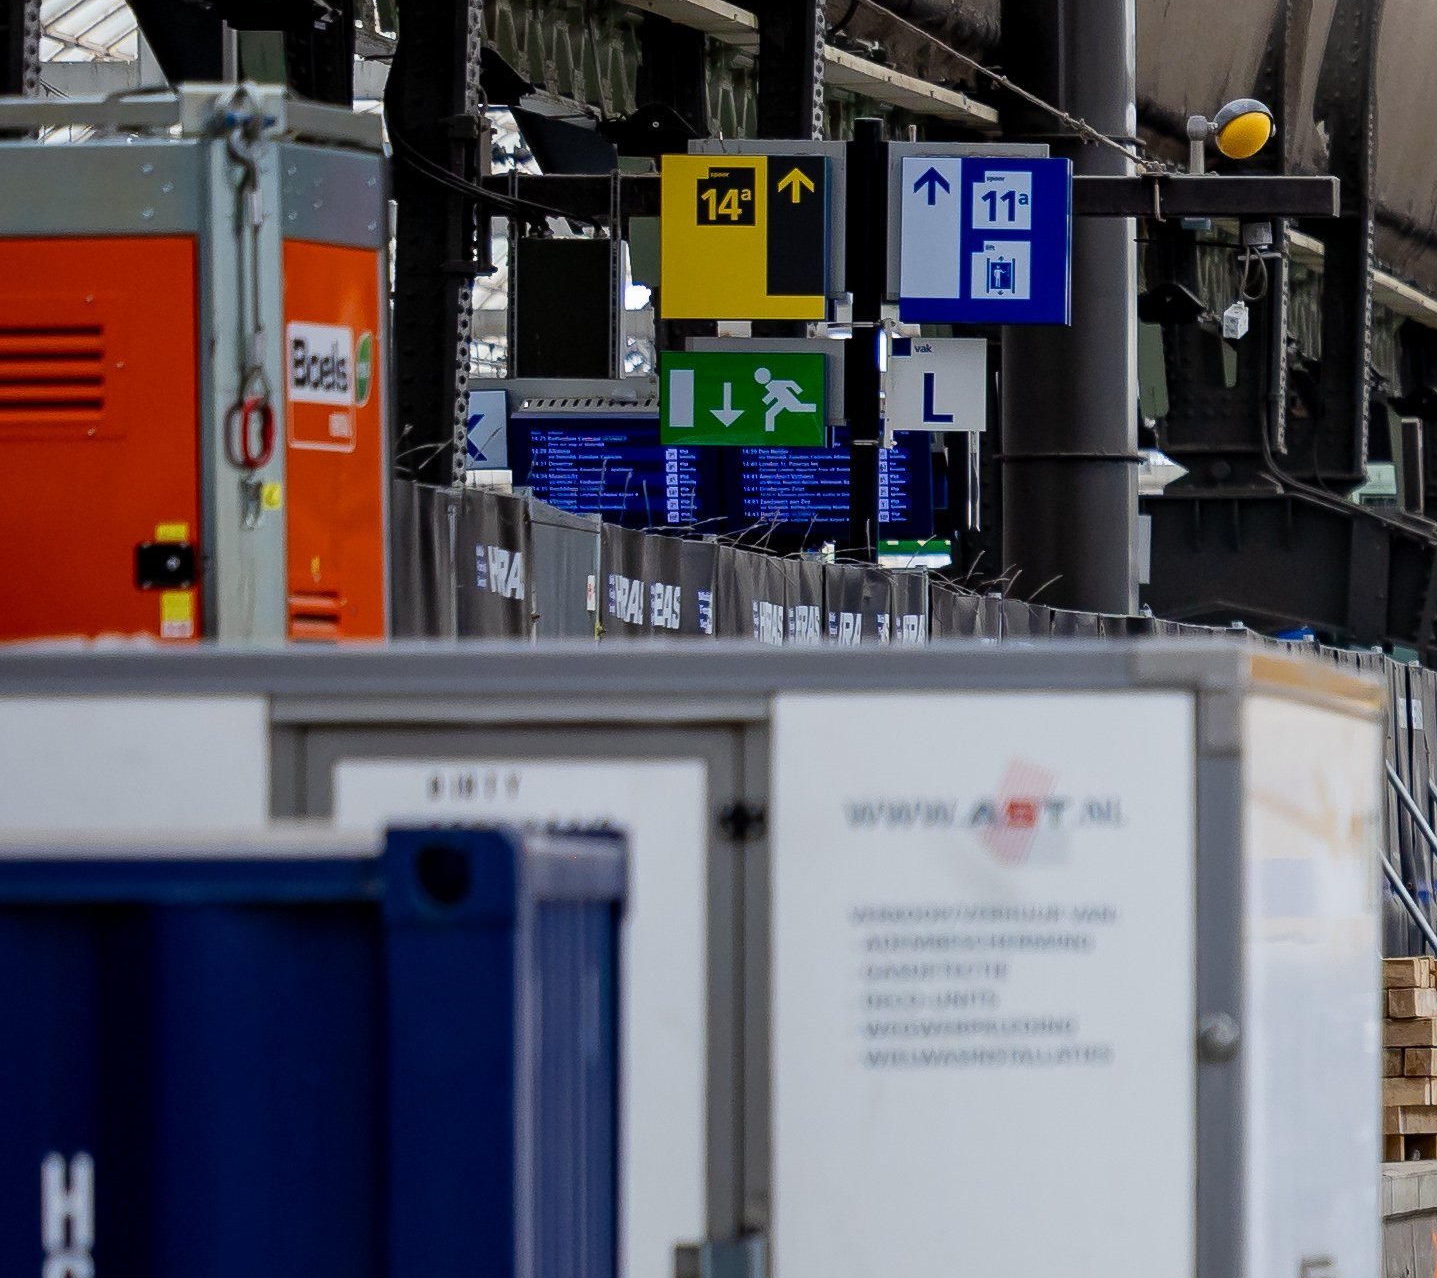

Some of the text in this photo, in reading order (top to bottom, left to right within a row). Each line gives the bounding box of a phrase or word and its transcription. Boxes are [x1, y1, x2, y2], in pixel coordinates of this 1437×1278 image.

[986, 175, 1006, 183] spoor
[914, 343, 933, 354] vak
[923, 372, 954, 423] L
